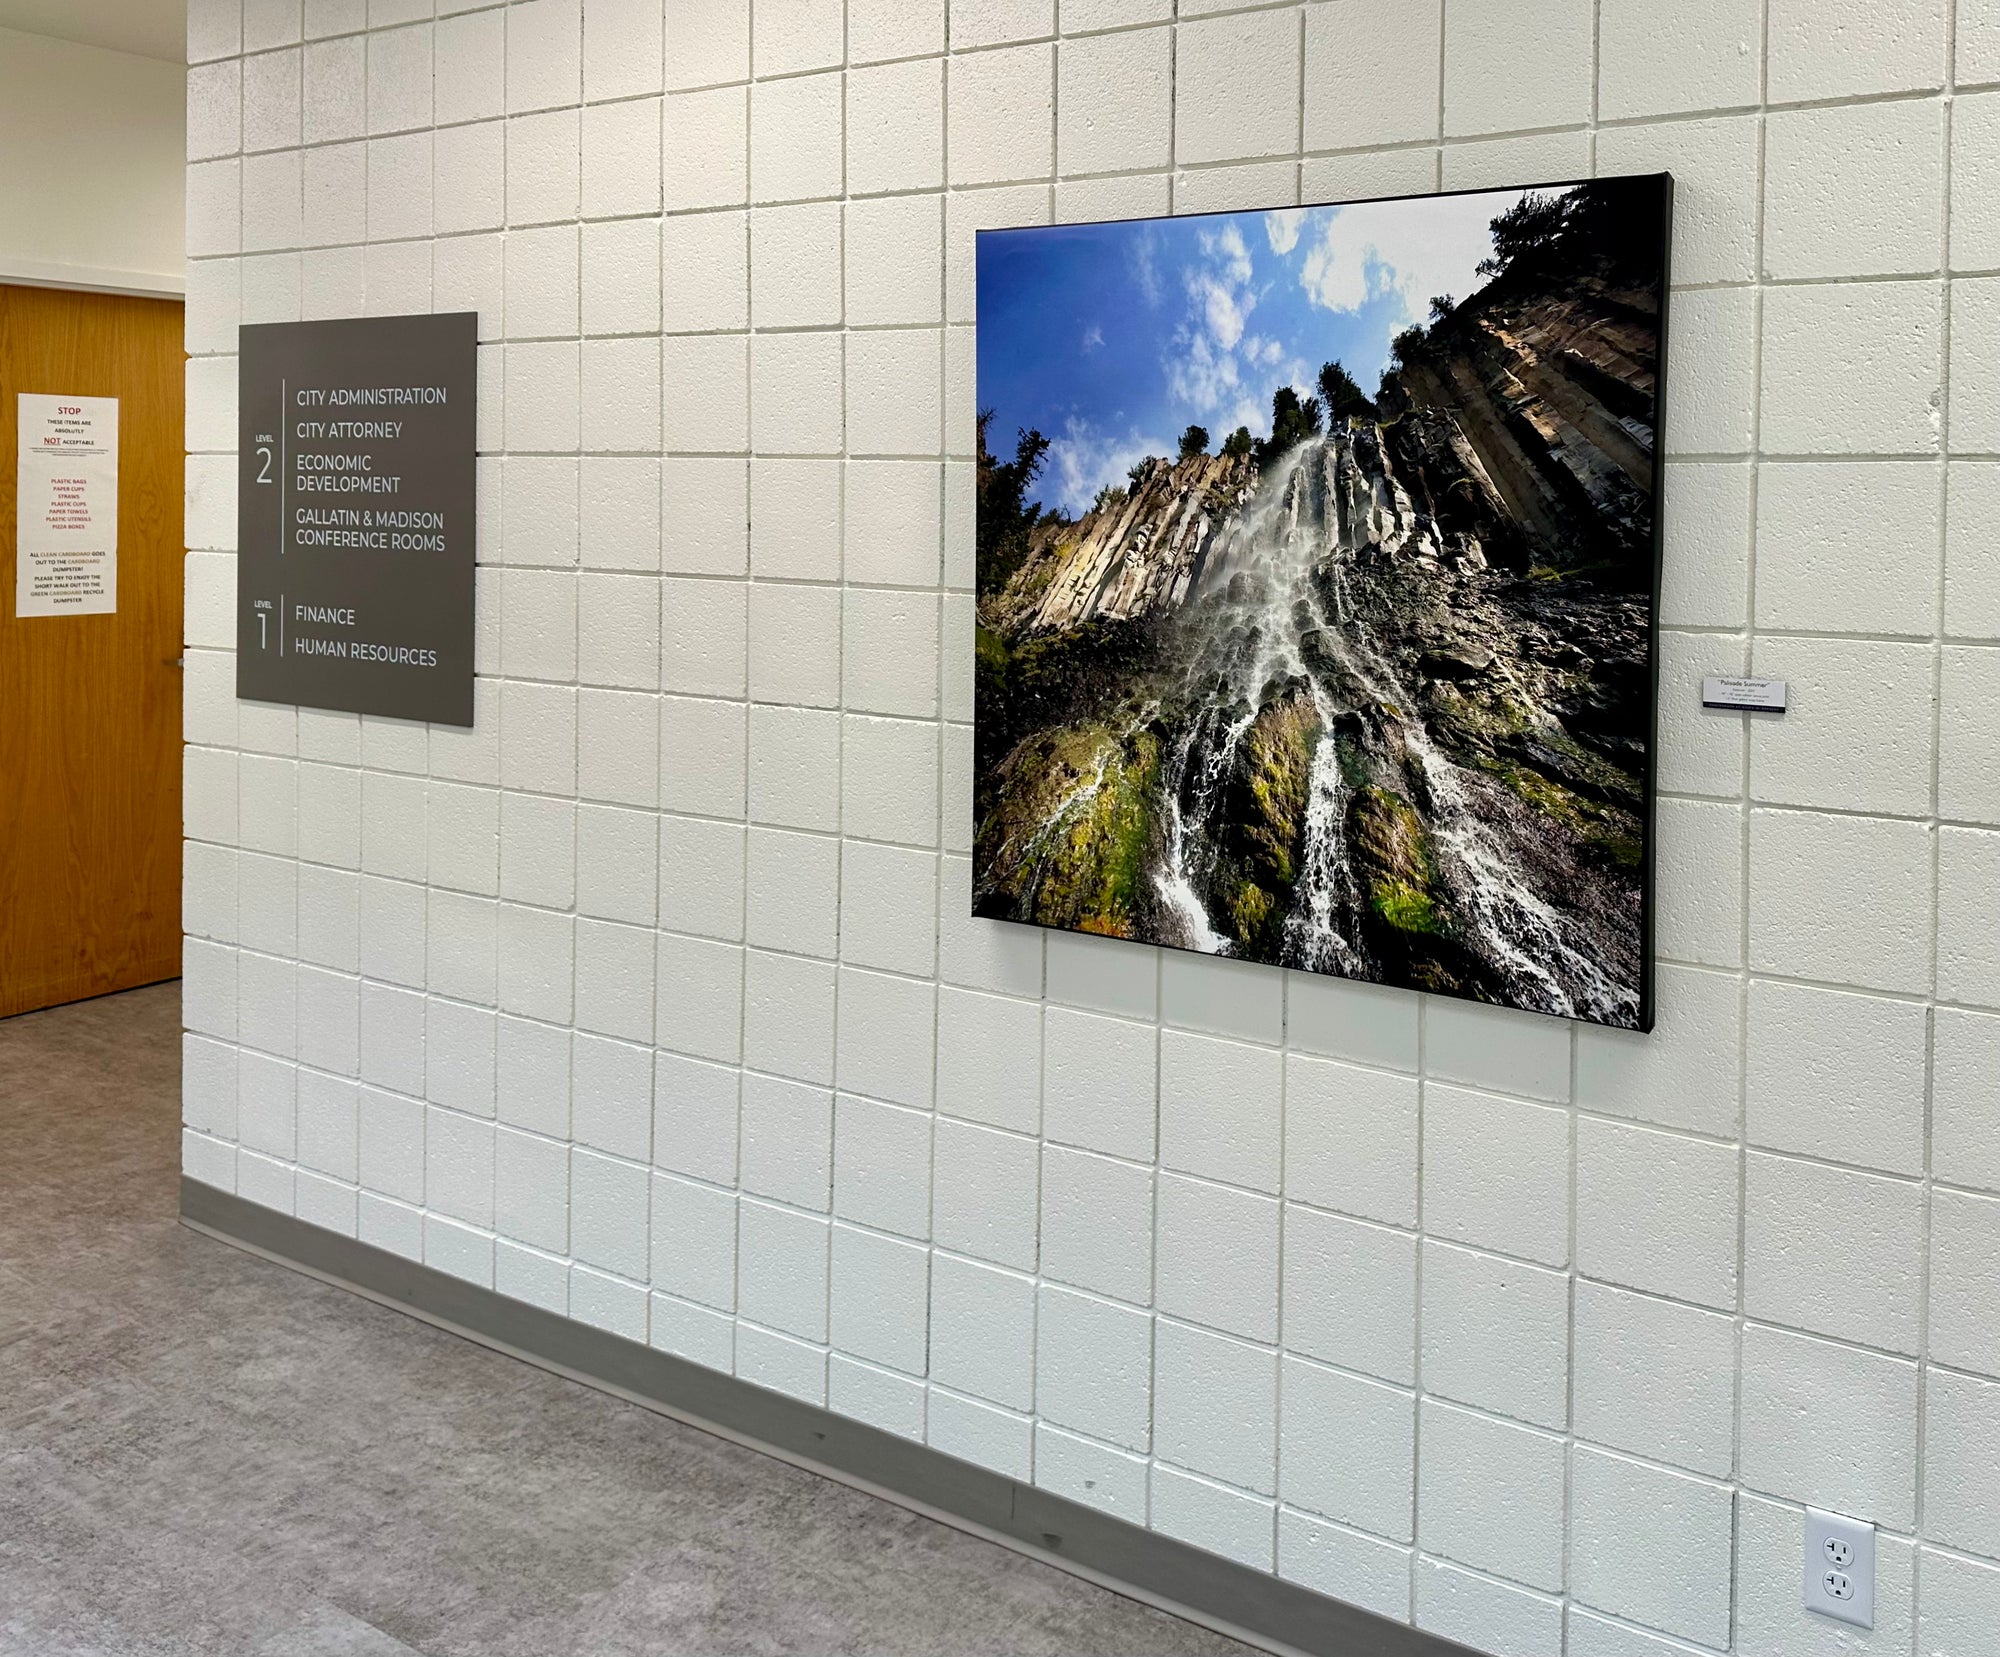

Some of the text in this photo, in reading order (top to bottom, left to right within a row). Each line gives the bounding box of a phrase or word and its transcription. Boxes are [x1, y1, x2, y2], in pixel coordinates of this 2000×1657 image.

[297, 388, 446, 406] CITY ADMINISTRATION
[297, 422, 402, 438] CITY ATTORNEY
[256, 448, 272, 484] 2
[297, 455, 371, 471] ECONOMIC
[297, 476, 400, 493] DEVELOPMENT
[296, 508, 443, 529] GALLATIN & MADISON
[296, 530, 445, 551] CONFERENCE ROOMS
[254, 600, 272, 609] LEVEL
[296, 606, 355, 625] FINANCE
[258, 613, 266, 649] 1
[296, 638, 437, 666] HUMAN RESOURCES
